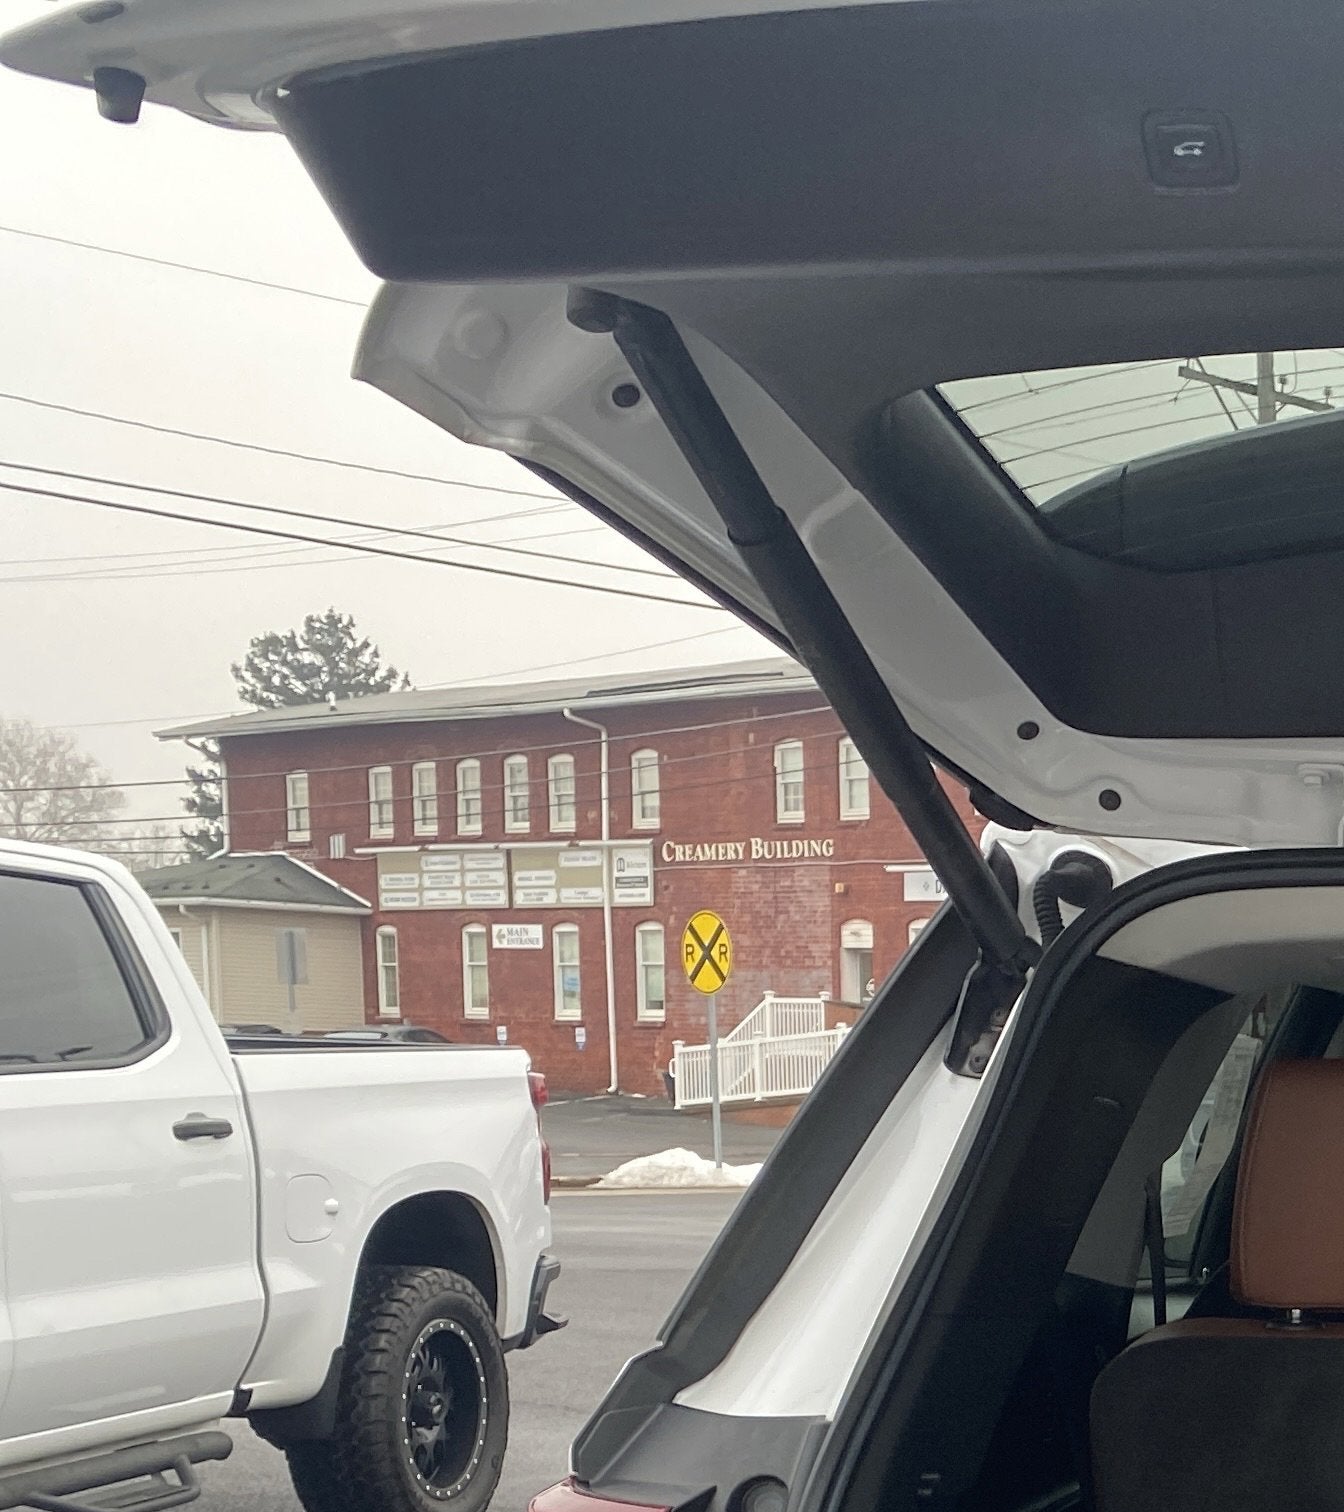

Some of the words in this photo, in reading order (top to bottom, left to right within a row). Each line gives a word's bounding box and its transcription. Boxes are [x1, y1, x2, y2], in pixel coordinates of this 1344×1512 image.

[661, 841, 746, 862] CREAMERY
[750, 837, 834, 859] BUILDING
[506, 927, 529, 937] MAIN
